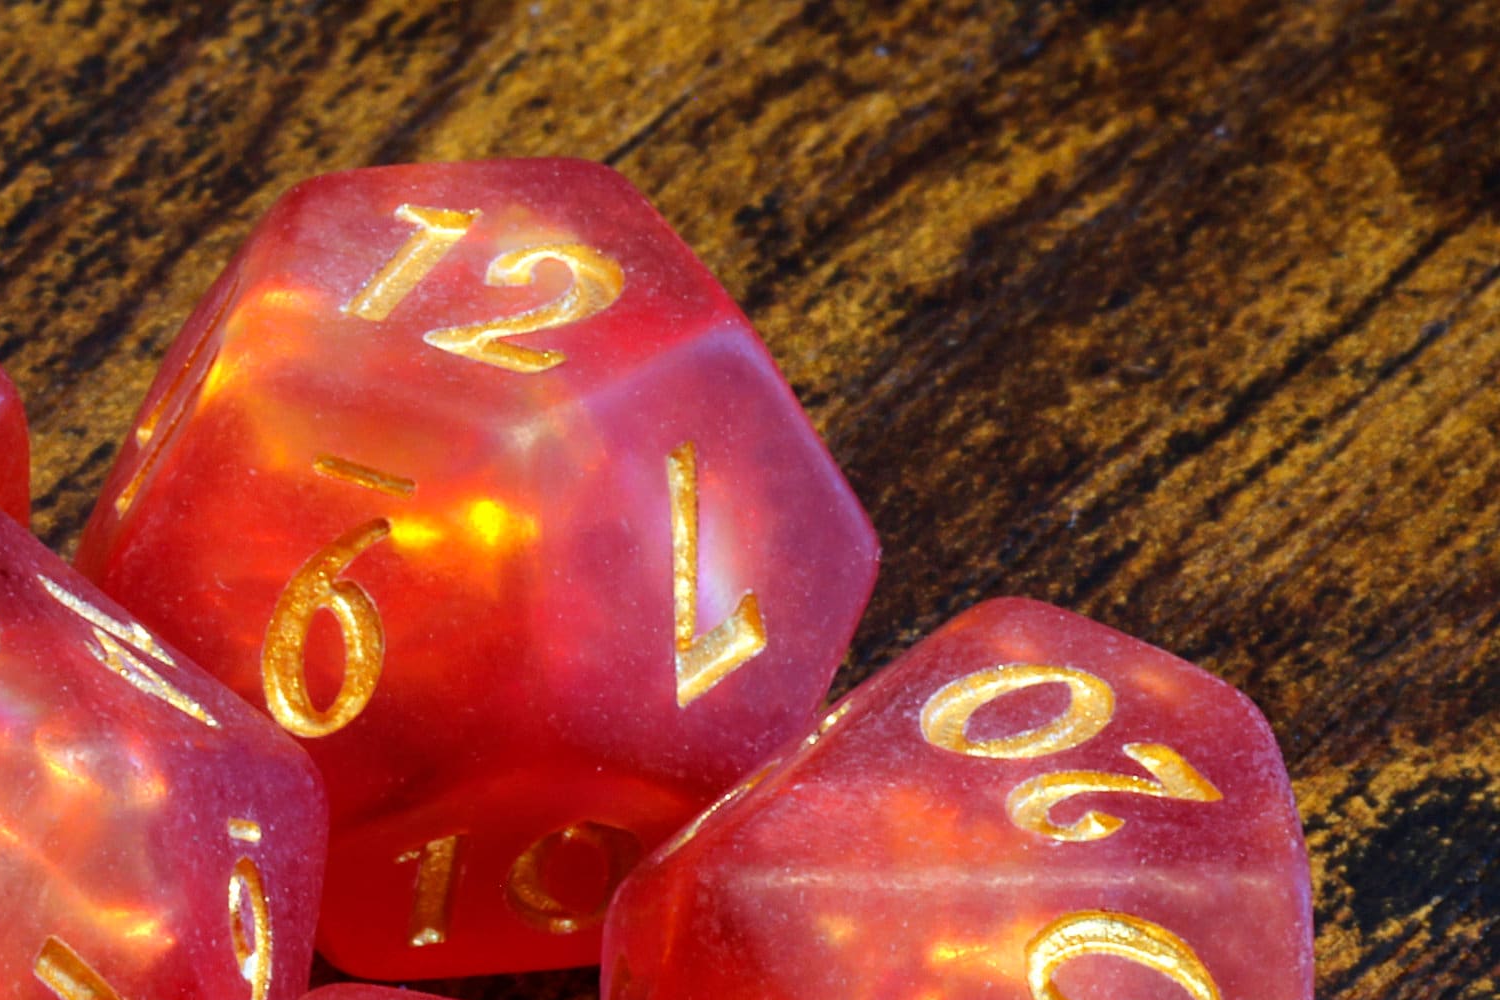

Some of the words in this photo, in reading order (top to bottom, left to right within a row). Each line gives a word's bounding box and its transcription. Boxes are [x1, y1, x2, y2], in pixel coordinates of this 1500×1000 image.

[340, 203, 626, 373] 12
[667, 441, 768, 708] 7
[920, 663, 1224, 842] 20
[394, 818, 648, 946] 10
